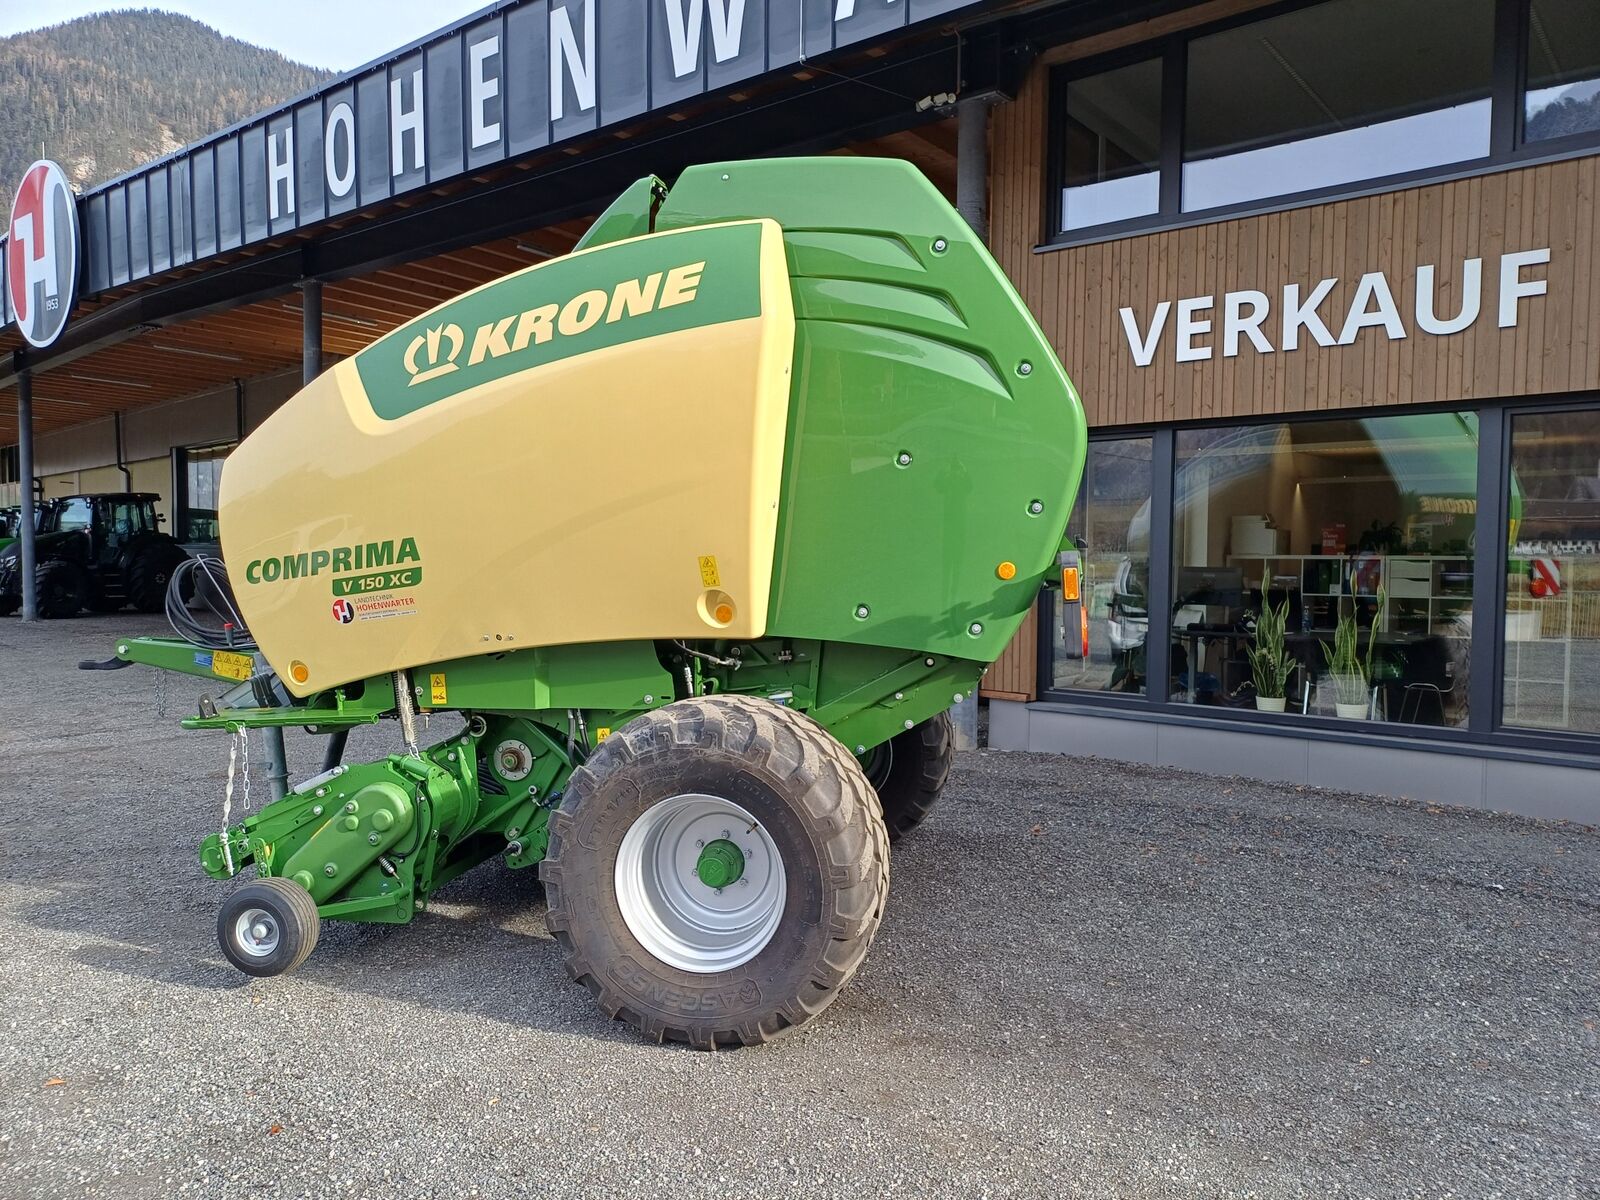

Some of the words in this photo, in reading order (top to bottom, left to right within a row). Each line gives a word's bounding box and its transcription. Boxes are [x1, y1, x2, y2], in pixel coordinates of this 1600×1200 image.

[267, 0, 896, 220] HOHENW
[46, 297, 59, 311] 1953
[467, 261, 706, 366] KRONE
[1118, 247, 1551, 367] VERKAUF
[246, 537, 421, 584] COMPRIMA
[342, 580, 354, 593] V
[358, 576, 384, 591] 150
[389, 572, 412, 587] XC
[354, 594, 394, 604] LANDTECHNIK
[356, 597, 415, 612] HOHENWARTER
[613, 963, 737, 1012] ASCENSO
